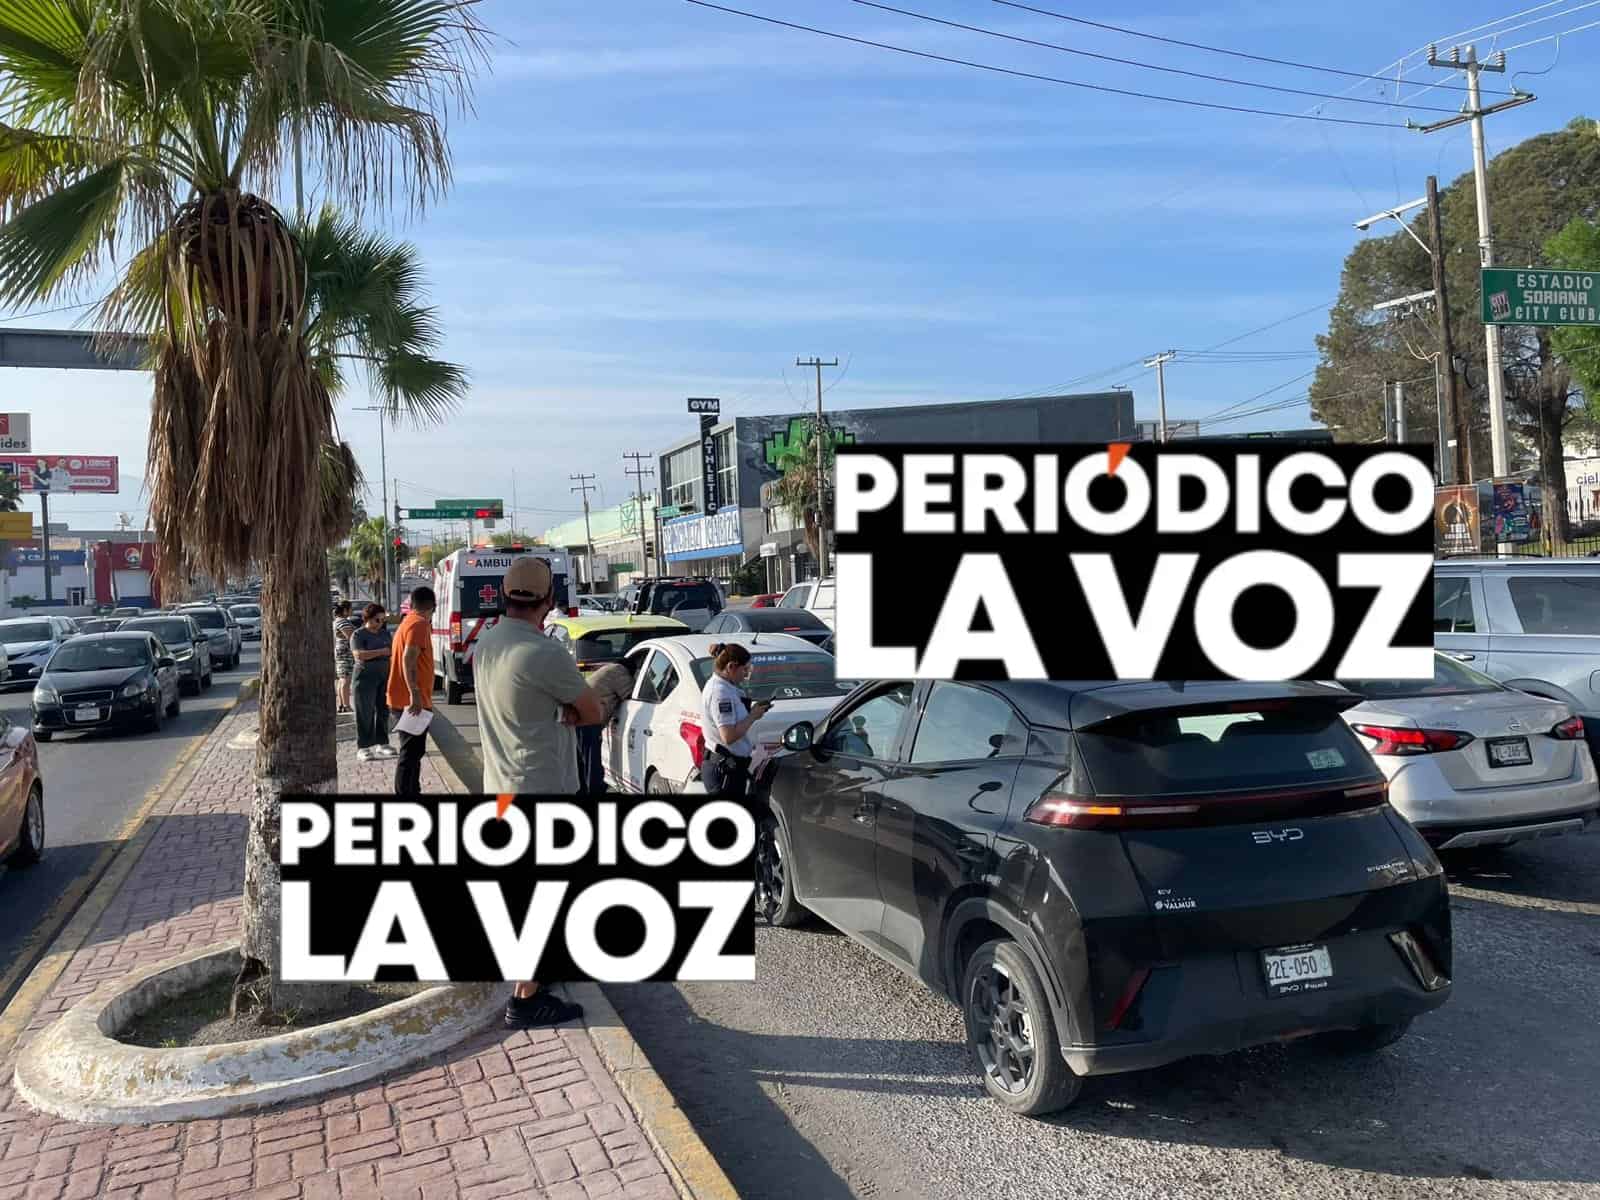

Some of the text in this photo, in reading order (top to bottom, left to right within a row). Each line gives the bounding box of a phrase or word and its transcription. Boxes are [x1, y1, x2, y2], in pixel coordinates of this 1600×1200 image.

[1517, 274, 1593, 289] ESTADIO
[1523, 290, 1588, 305] SORIANA
[1515, 306, 1595, 321] CITY CLUB
[689, 400, 718, 410] GYM
[703, 436, 717, 511] ATHLETIC
[474, 558, 512, 569] AMBUL
[783, 687, 802, 697] 93
[1251, 828, 1305, 844] BYD
